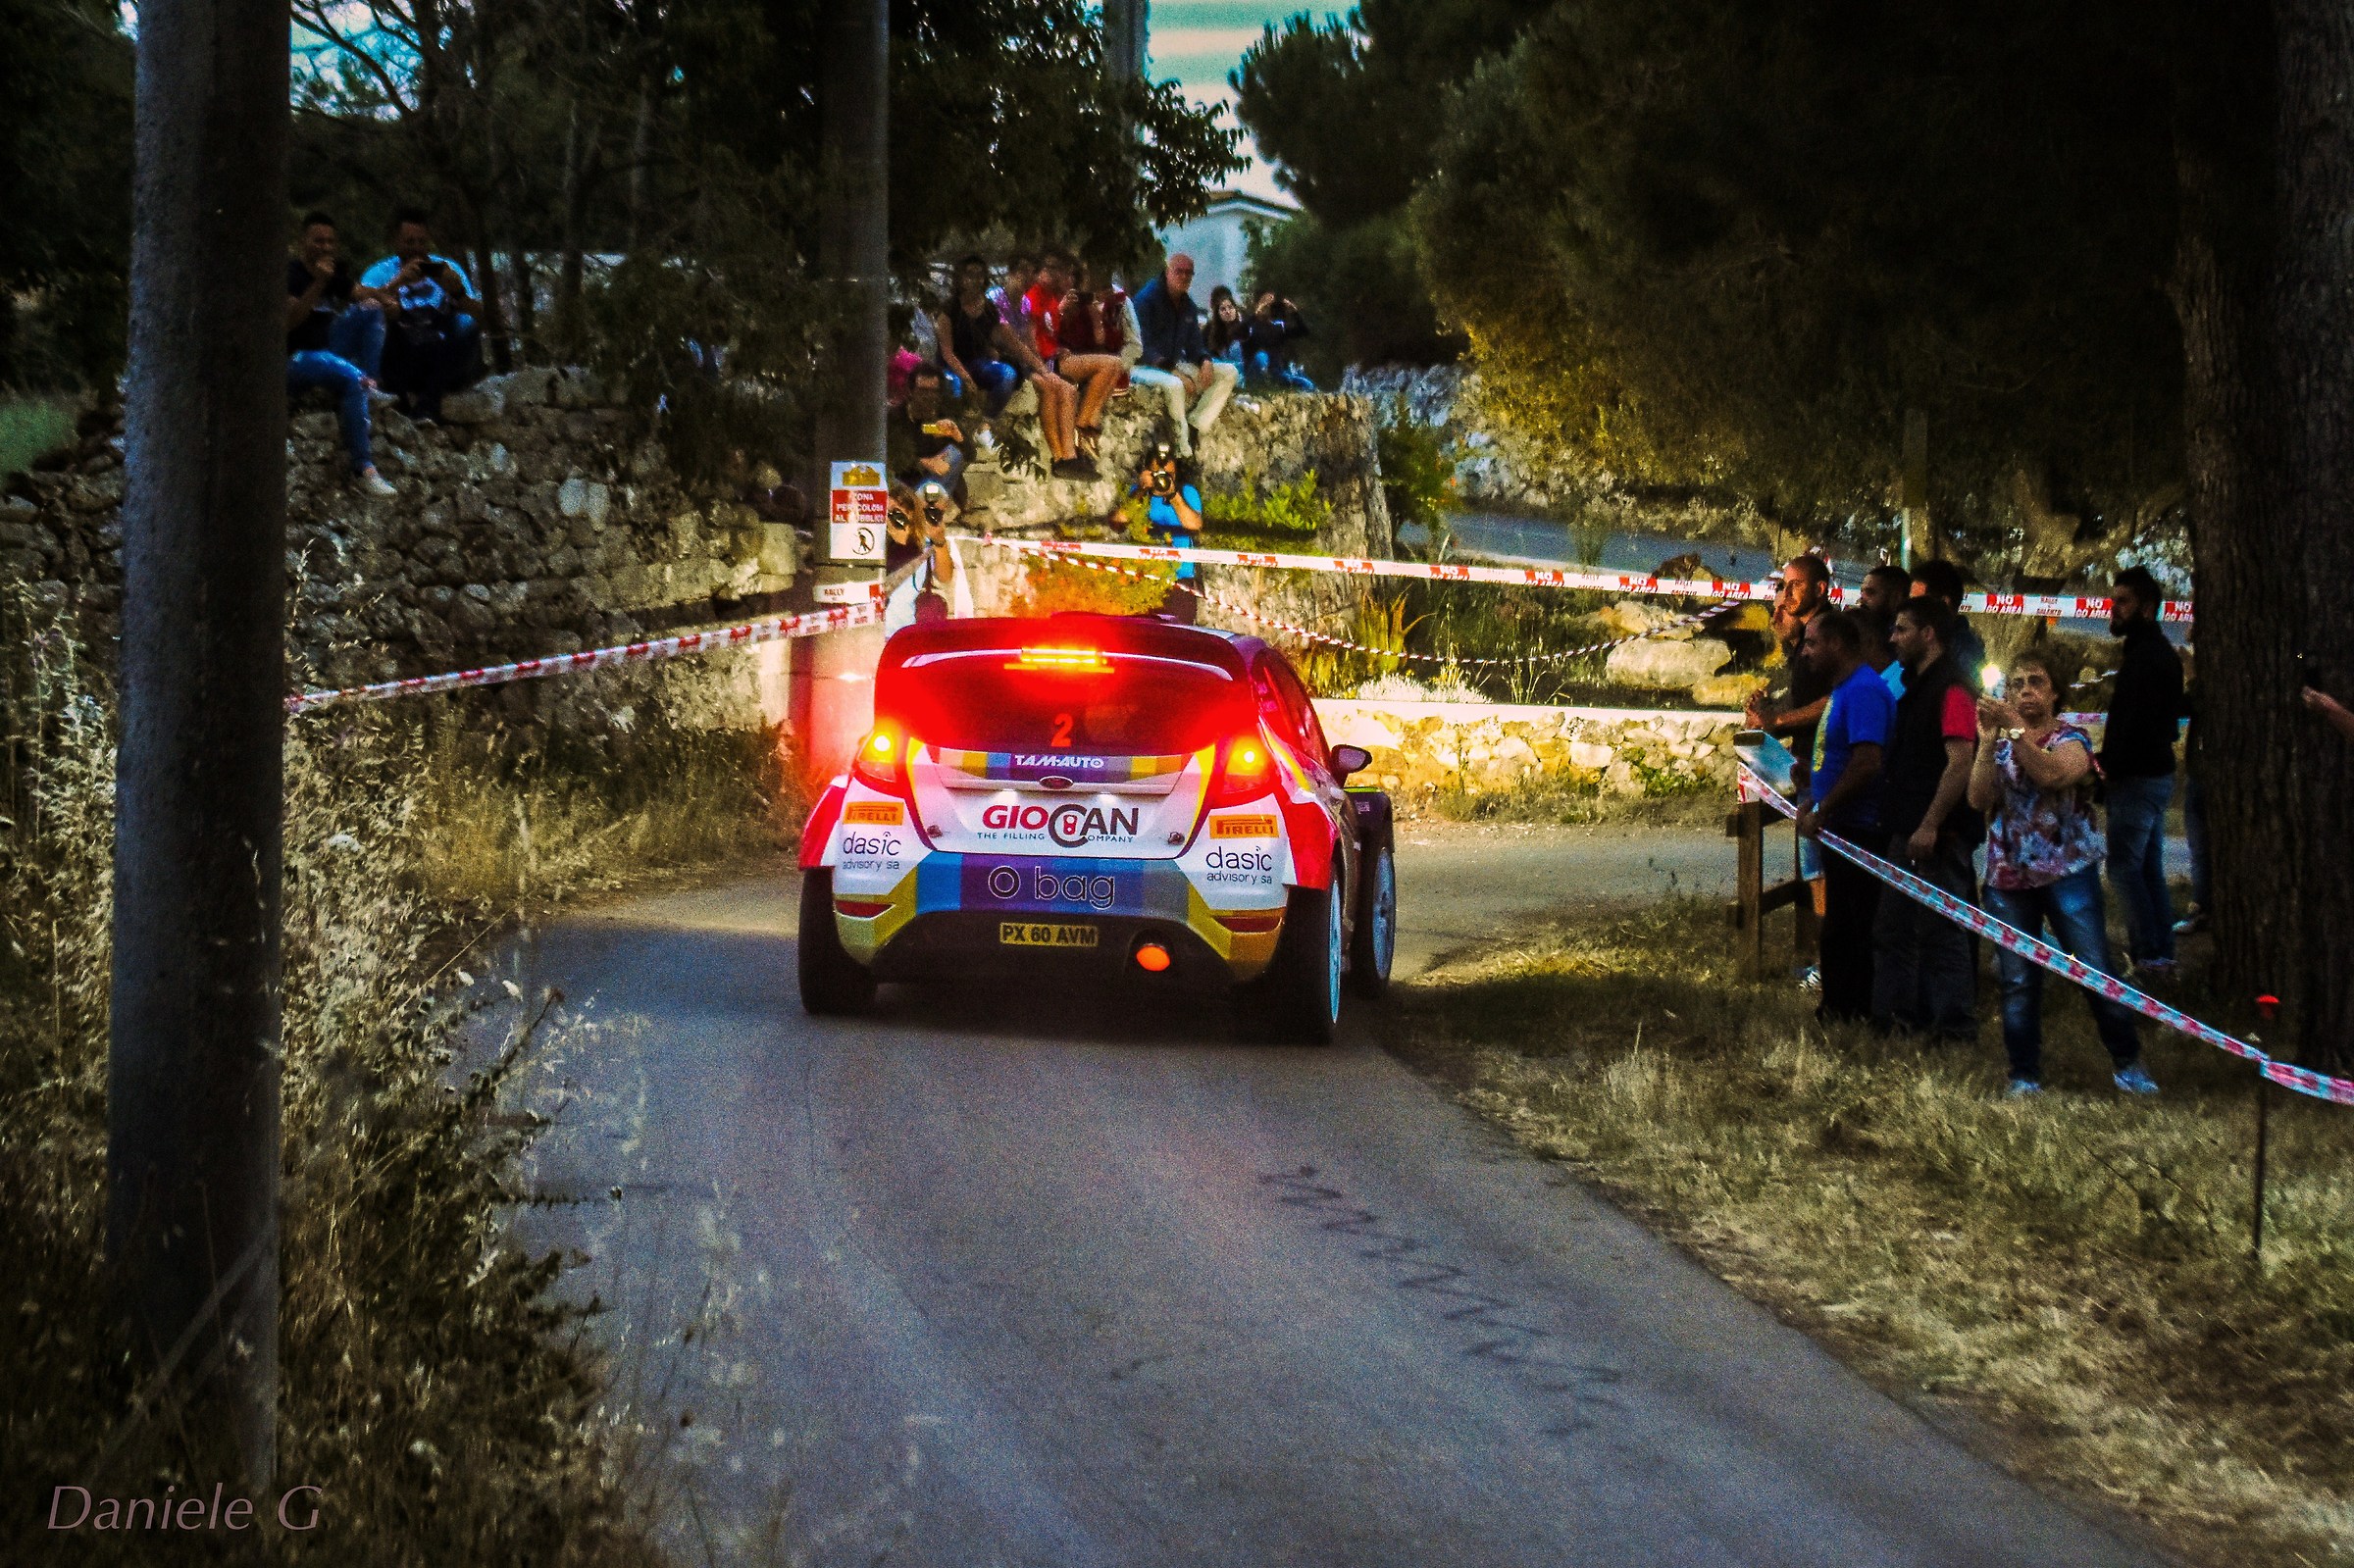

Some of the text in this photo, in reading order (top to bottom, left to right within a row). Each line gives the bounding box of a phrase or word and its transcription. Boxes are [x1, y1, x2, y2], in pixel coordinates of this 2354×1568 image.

[1535, 571, 1553, 582] NO
[1629, 577, 1648, 586] NO
[1722, 582, 1740, 591] NO
[1996, 594, 2014, 605] NO
[2086, 598, 2104, 609] NO
[2000, 605, 2021, 614] AREA
[2175, 601, 2192, 613] NO
[2076, 609, 2112, 619] GO AREA
[2165, 612, 2176, 622] GO
[1050, 713, 1074, 747] 2
[982, 803, 1139, 848] GIOCAN
[1216, 819, 1274, 835] PIRELLI
[978, 832, 998, 840] THE
[1003, 832, 1046, 841] FILLING
[843, 832, 901, 856] dasic
[1205, 845, 1272, 871] dasic
[843, 859, 899, 872] advisory sa
[1206, 871, 1272, 885] advisory sa
[988, 865, 1115, 910] O bag
[1002, 925, 1096, 944] PX 60 AVM
